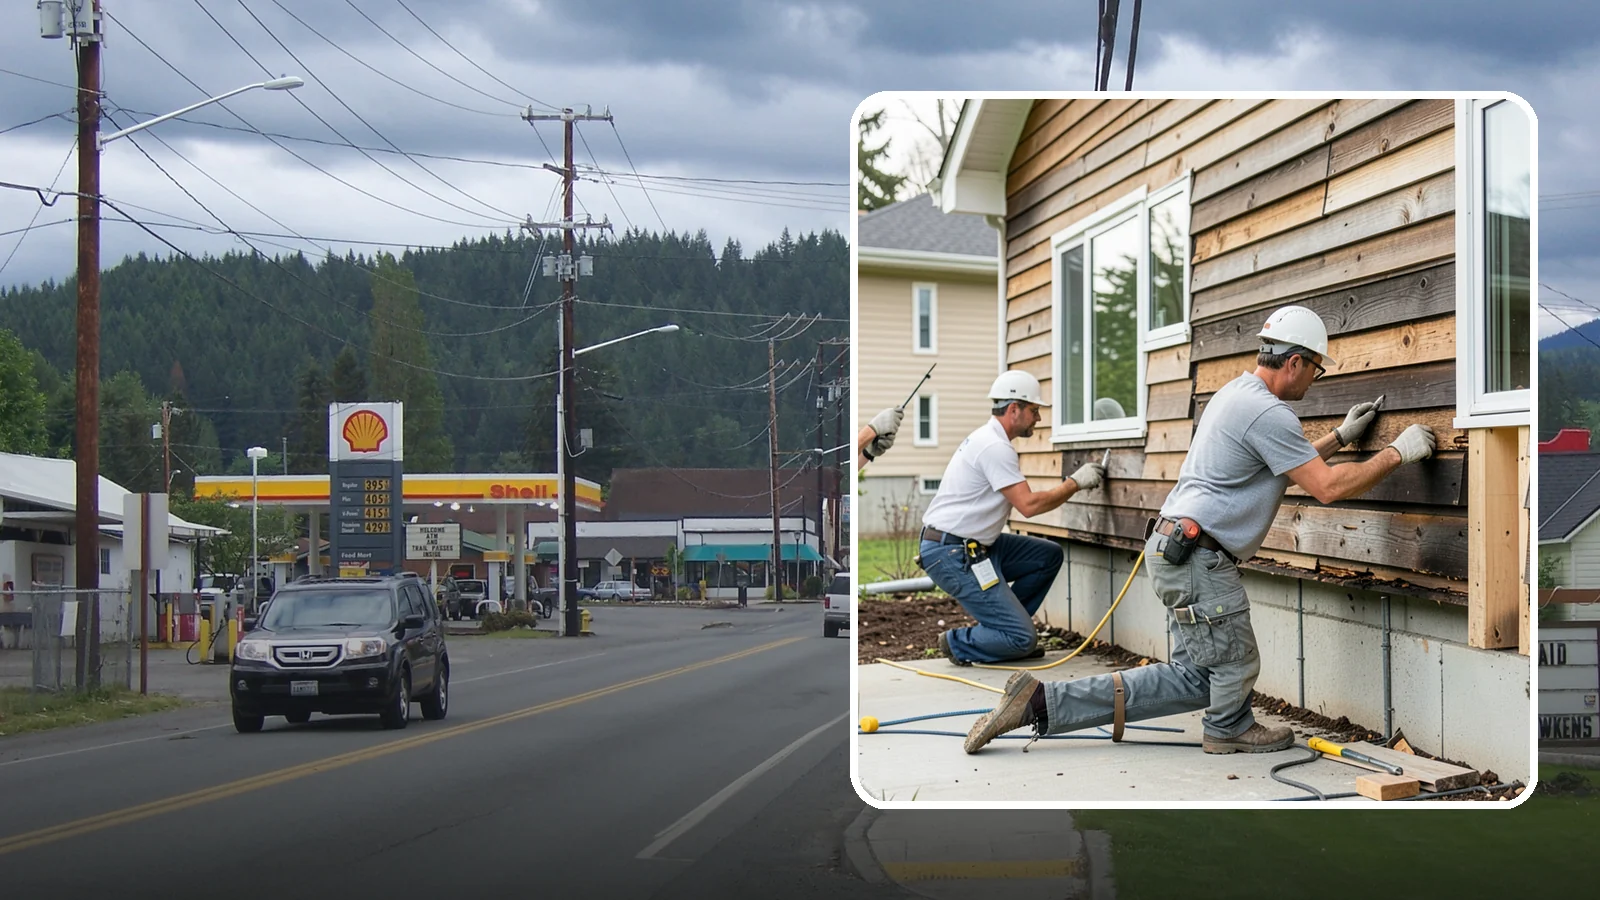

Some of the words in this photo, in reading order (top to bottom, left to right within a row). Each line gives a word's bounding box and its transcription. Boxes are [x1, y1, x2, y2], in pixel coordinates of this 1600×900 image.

[366, 480, 384, 490] 395
[490, 484, 547, 499] Shell
[366, 494, 384, 504] 405
[366, 508, 384, 518] 415
[366, 522, 384, 532] 429
